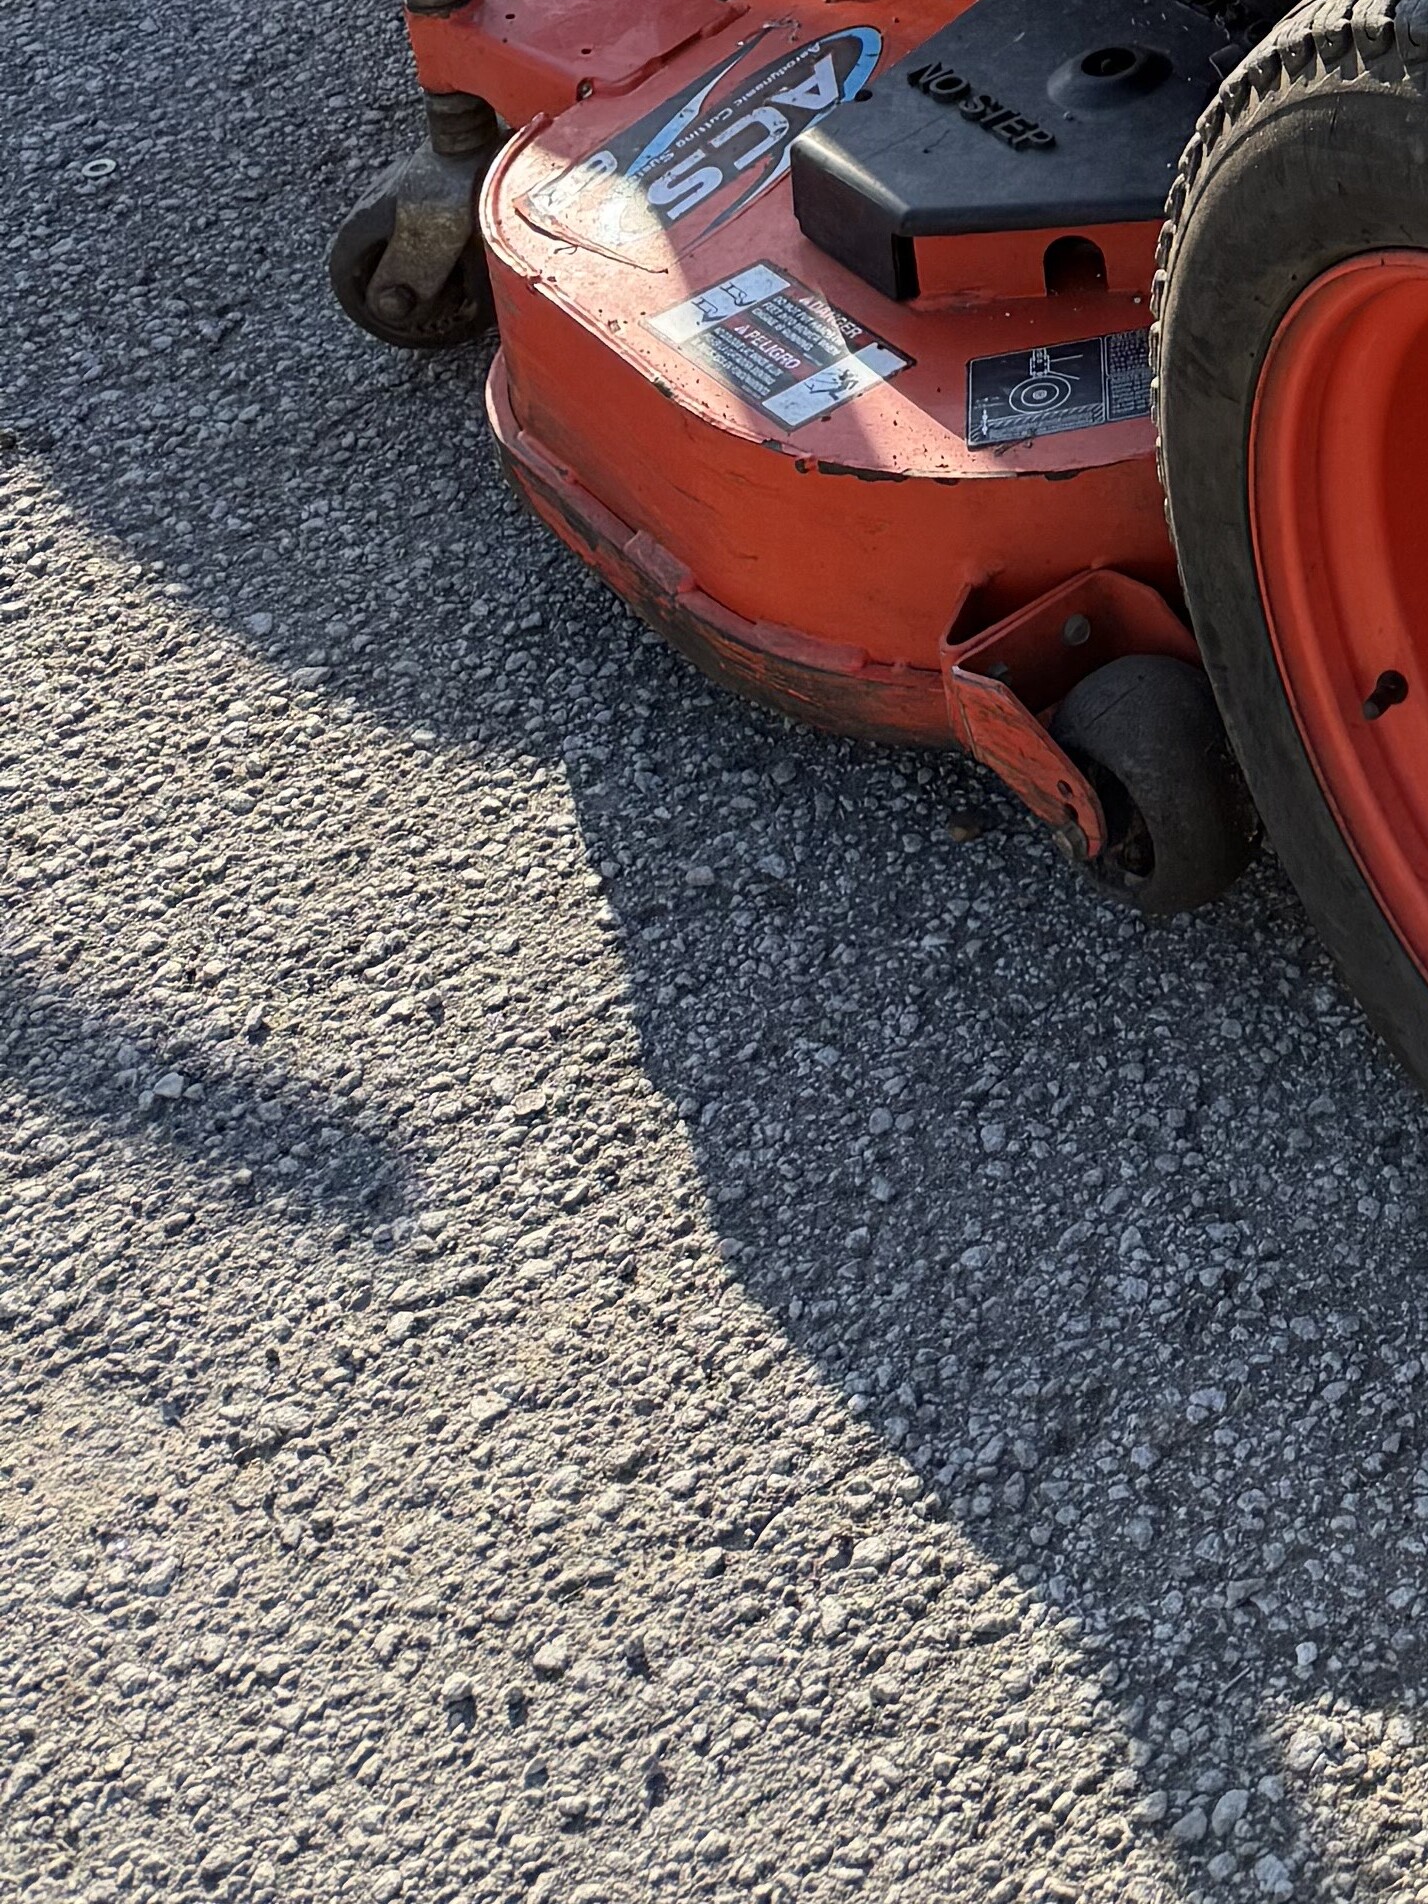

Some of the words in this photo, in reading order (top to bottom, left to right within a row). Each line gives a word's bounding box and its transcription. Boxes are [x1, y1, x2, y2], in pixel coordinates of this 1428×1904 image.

[734, 42, 822, 107] Aerodynamic
[676, 107, 734, 149] Cutting
[907, 61, 971, 103] NO
[959, 93, 1057, 151] STEP
[647, 53, 839, 221] ACS
[805, 300, 865, 338] DANGER
[741, 329, 804, 371] PELIGRO
